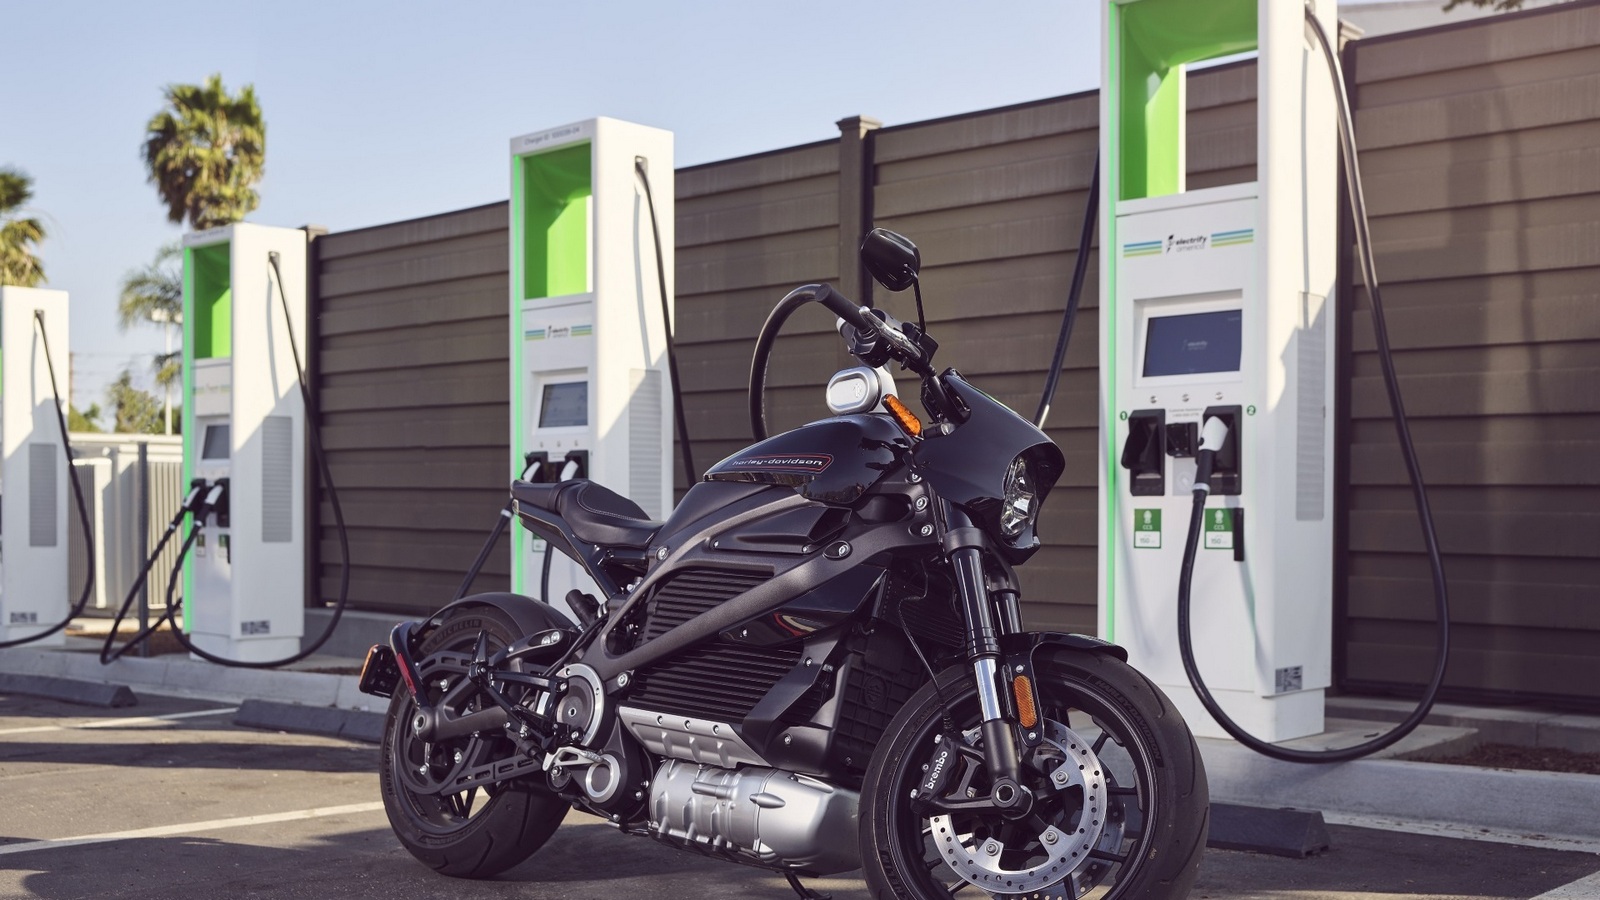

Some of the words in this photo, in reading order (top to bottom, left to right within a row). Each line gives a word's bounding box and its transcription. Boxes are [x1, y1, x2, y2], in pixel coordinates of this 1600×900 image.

[1175, 235, 1207, 246] electrify
[1176, 243, 1205, 252] america
[731, 457, 824, 466] harley-davidson
[924, 751, 948, 789] brembo
